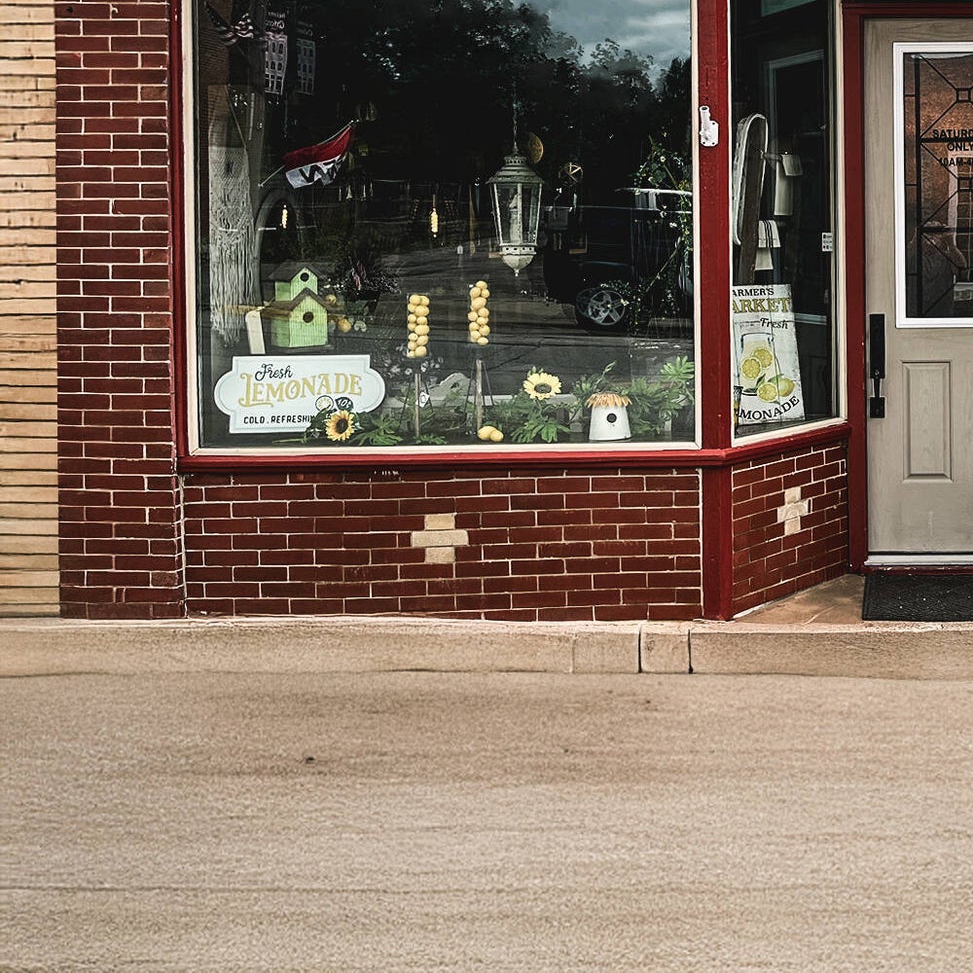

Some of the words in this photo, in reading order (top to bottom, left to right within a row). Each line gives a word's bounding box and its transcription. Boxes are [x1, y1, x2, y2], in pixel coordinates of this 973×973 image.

[732, 287, 775, 297] ARMER'S
[732, 297, 791, 314] ARKET
[760, 317, 788, 329] Fresh
[254, 363, 293, 382] Fresh
[238, 372, 363, 408] LEMONADE
[738, 395, 800, 421] MONADE
[271, 414, 315, 425] REFRESHI
